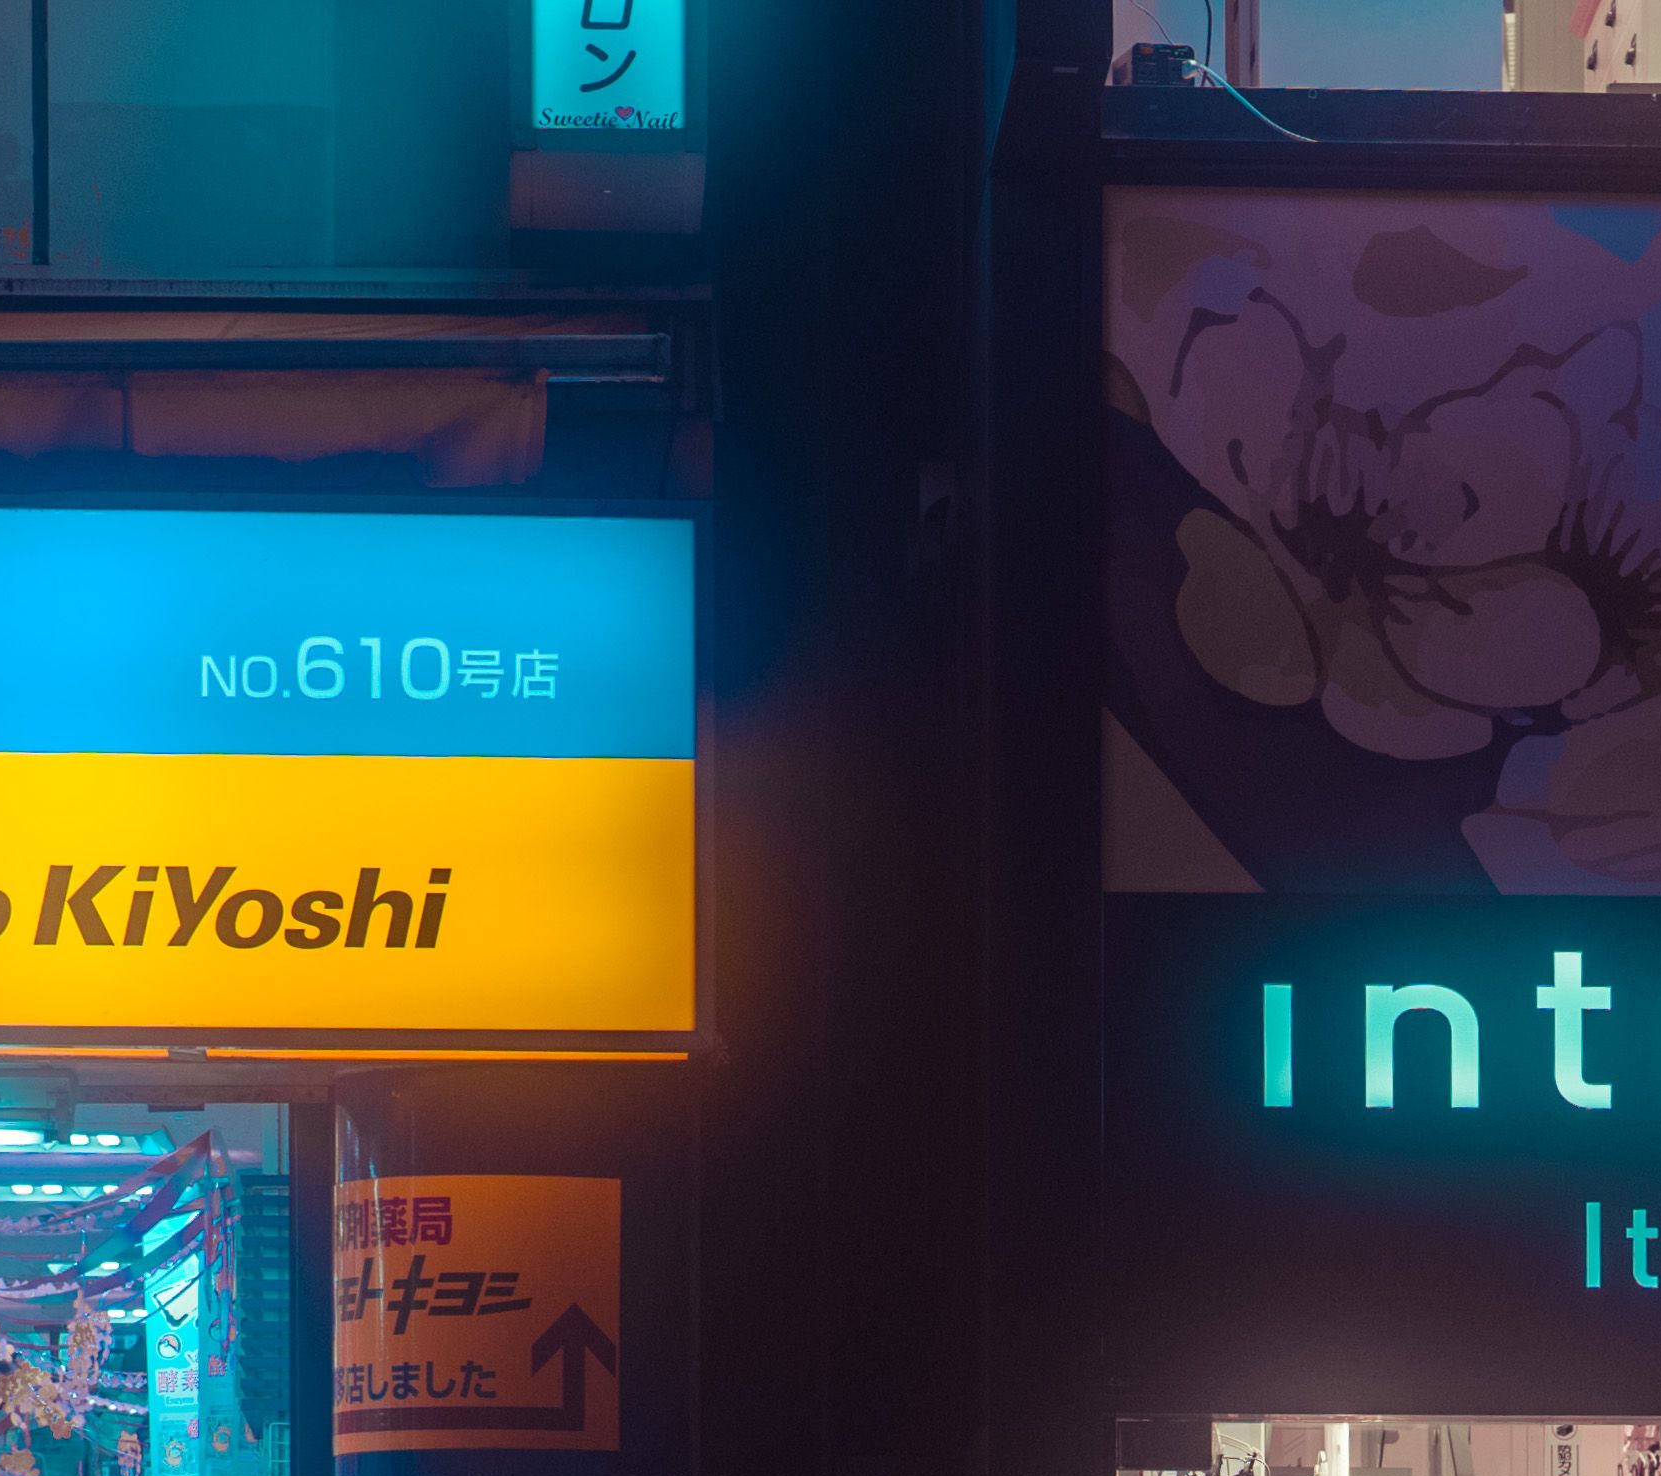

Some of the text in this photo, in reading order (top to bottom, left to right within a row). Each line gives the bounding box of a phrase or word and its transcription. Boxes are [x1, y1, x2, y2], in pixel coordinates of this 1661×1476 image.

[538, 106, 680, 131] Sweetie Nail
[33, 862, 453, 951] KiYoshi
